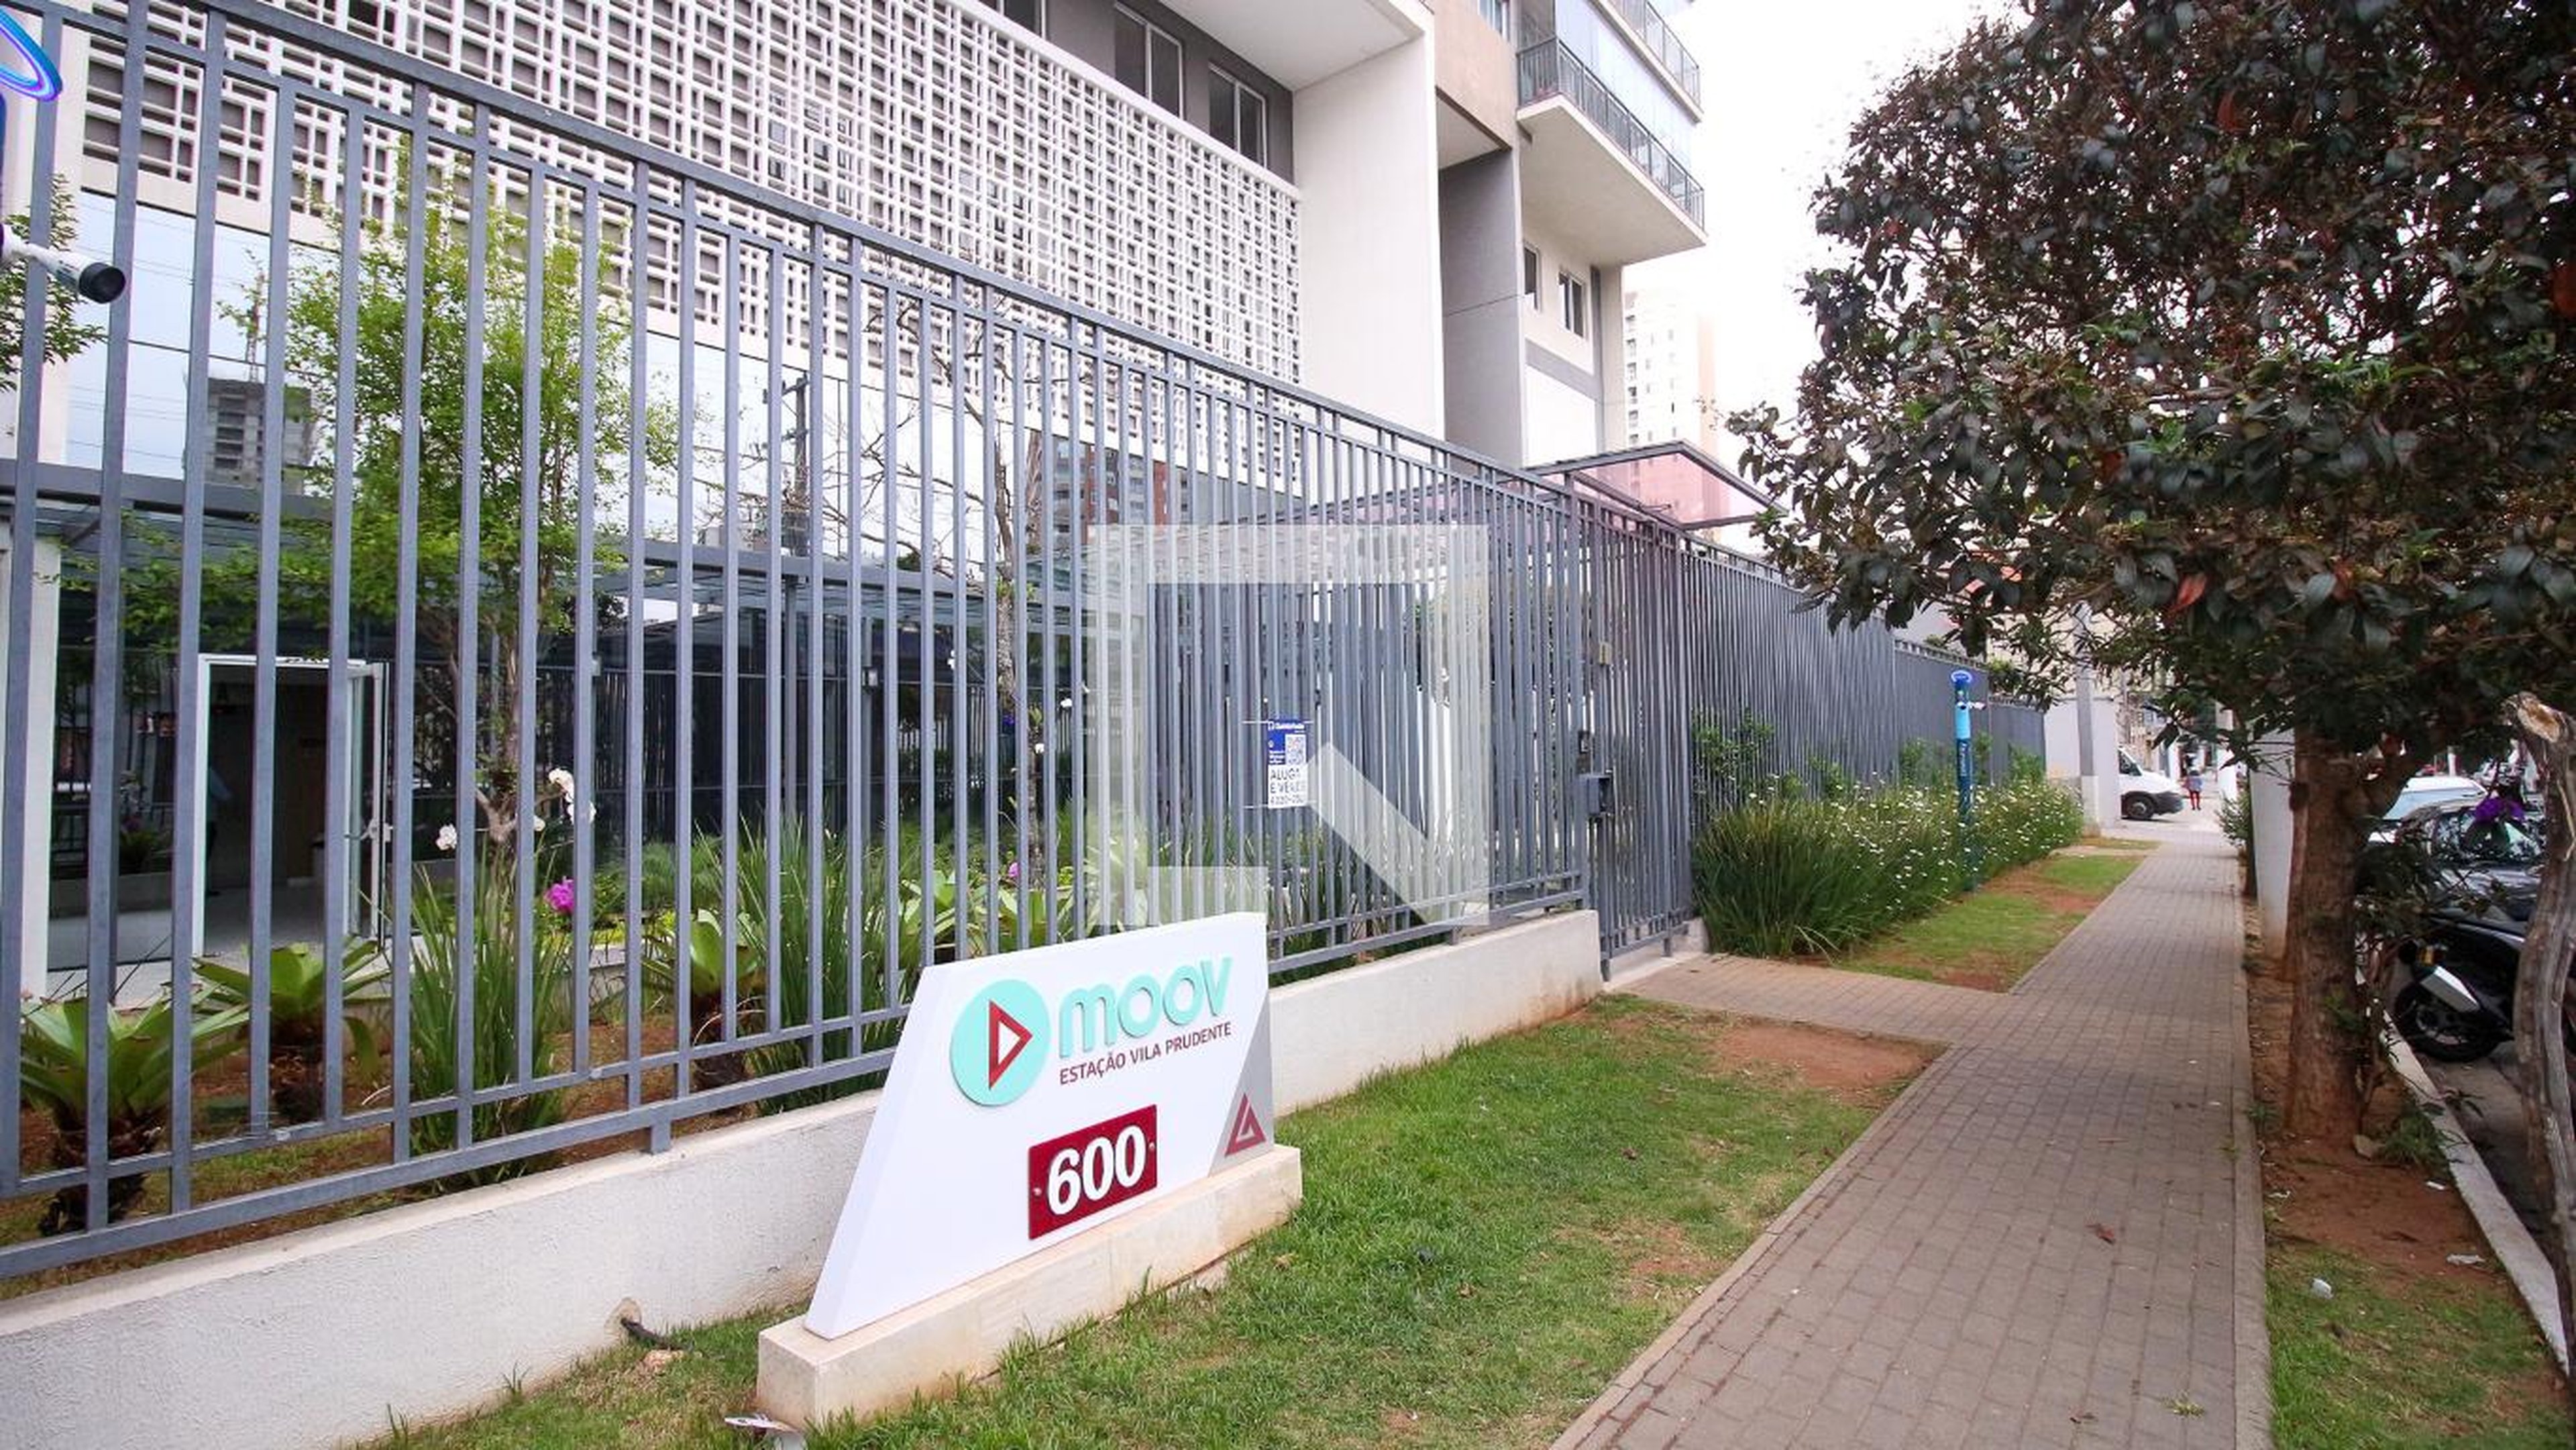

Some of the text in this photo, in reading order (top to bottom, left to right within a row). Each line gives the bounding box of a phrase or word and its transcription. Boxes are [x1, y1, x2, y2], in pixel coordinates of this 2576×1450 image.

[1059, 1021, 1232, 1085] ESTAÇÃO VILA PRUDENTE
[1048, 1125, 1146, 1215] 600
